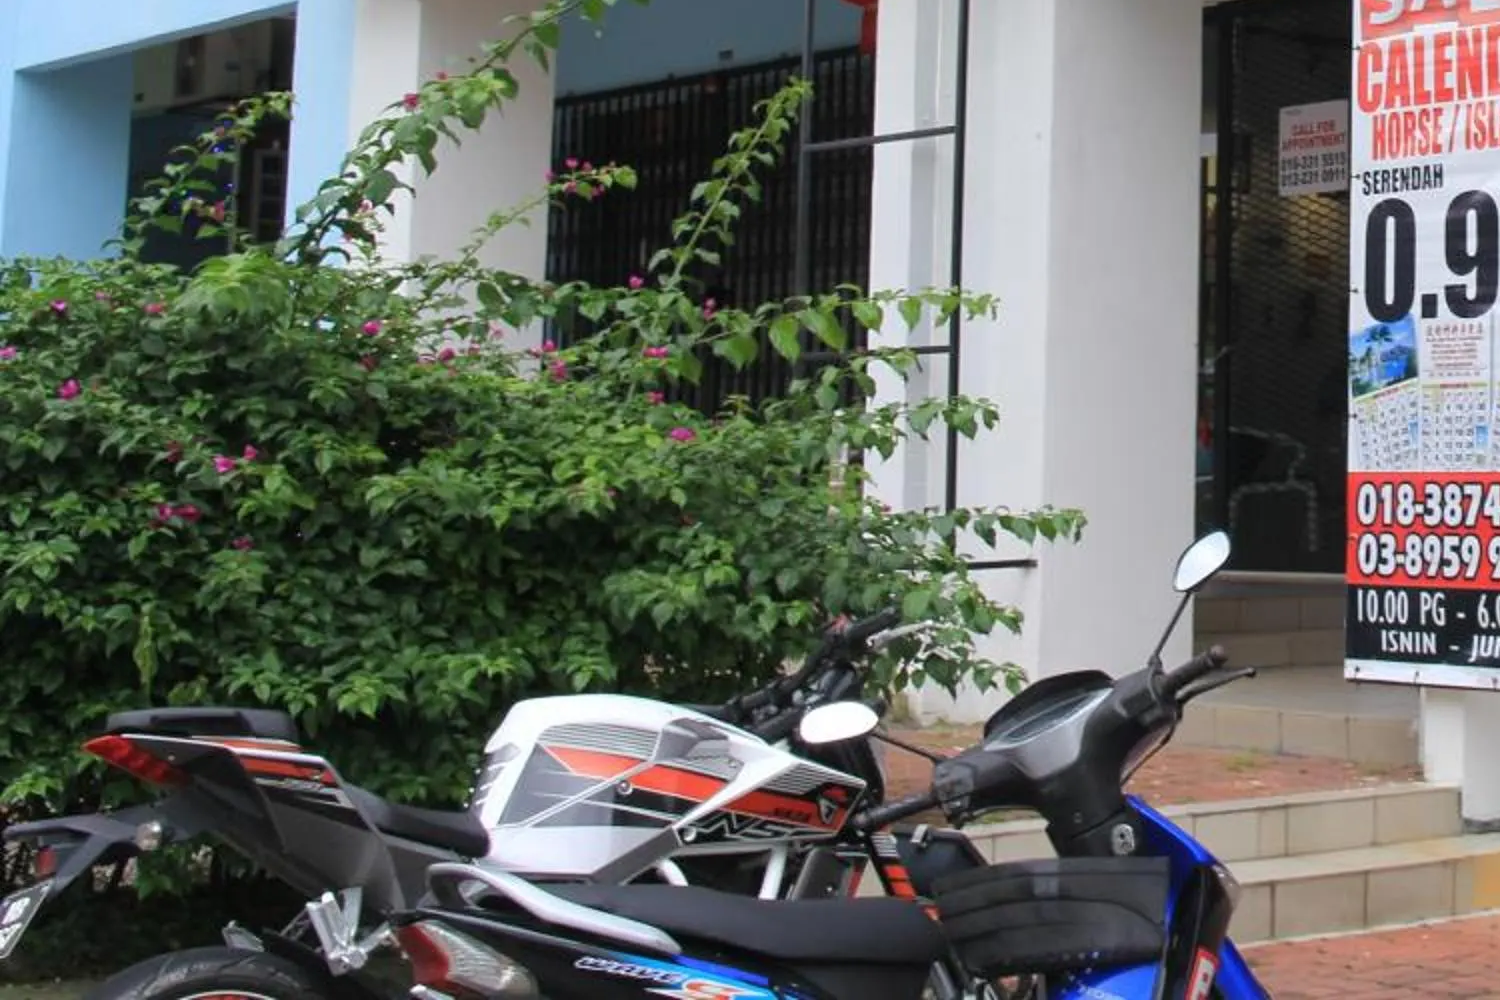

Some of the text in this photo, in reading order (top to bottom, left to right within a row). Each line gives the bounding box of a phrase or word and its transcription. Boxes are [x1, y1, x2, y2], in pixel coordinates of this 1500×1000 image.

[1372, 104, 1444, 160] HORSE
[1362, 163, 1444, 196] SERENDAH
[1357, 532, 1483, 579] 03-8959
[1356, 588, 1410, 625] 10.00
[1419, 590, 1446, 627] PG
[1380, 629, 1437, 654] ISNIN
